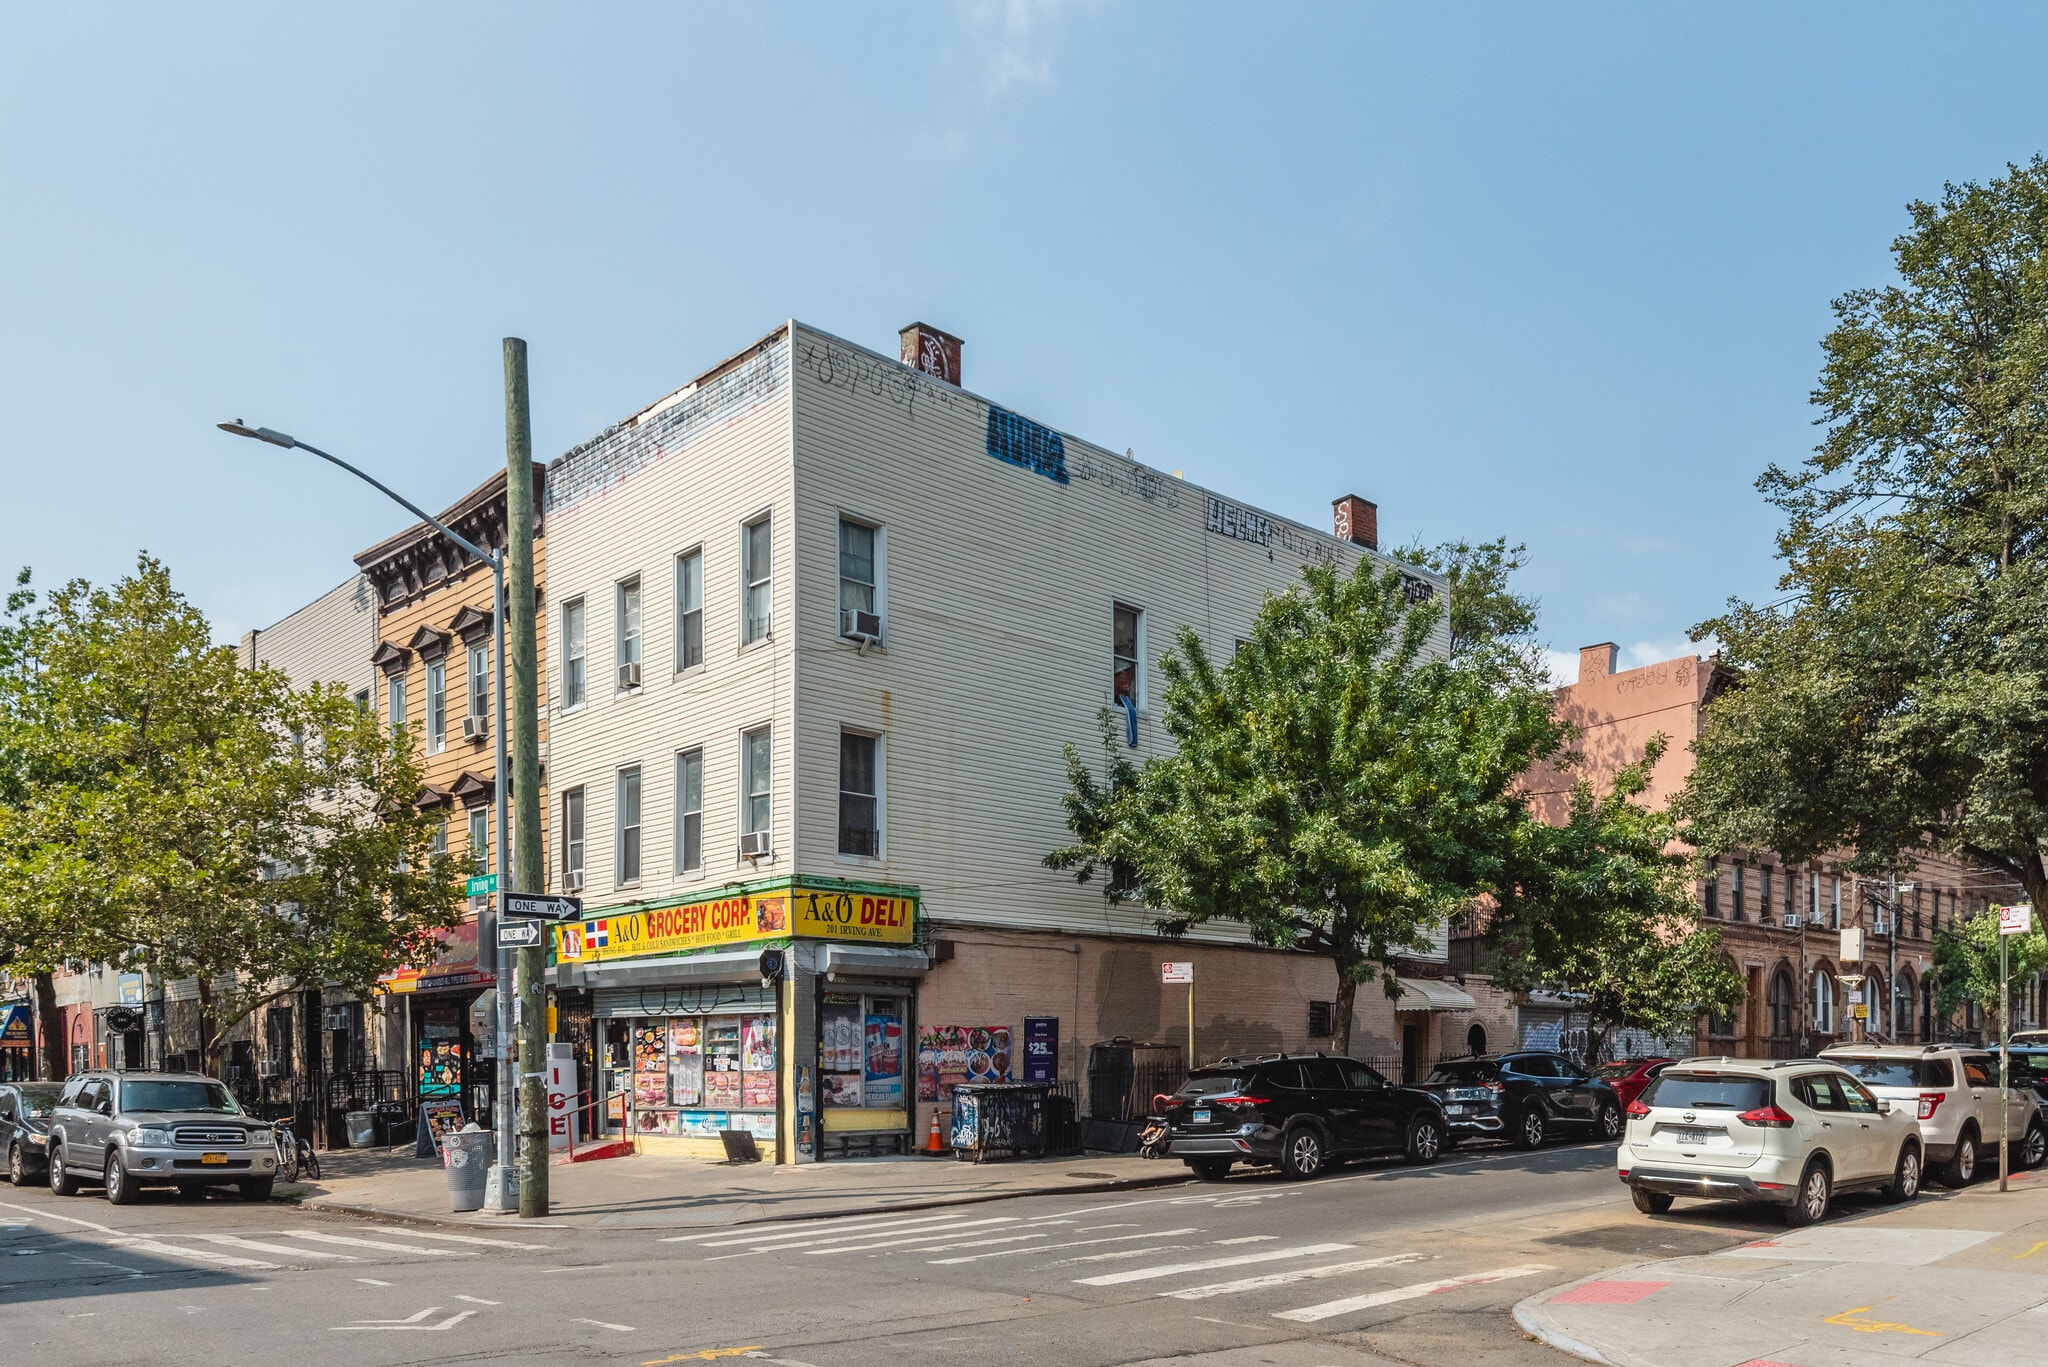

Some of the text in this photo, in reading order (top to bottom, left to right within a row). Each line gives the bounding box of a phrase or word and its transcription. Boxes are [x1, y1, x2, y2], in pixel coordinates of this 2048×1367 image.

[472, 879, 488, 893] Irving
[515, 901, 569, 913] ONE WAY
[804, 894, 906, 928] A&O DELI
[614, 898, 750, 944] A&O GROCERY CORP.
[504, 928, 533, 939] ONE WAY
[826, 924, 884, 938] 201 IRVING AVE.
[632, 943, 641, 952] HOT
[647, 940, 660, 950] COLD
[660, 935, 691, 949] SANDWICHES
[695, 934, 703, 944] HOT
[704, 932, 721, 943] FOOD
[725, 930, 741, 940] GRILL
[549, 1067, 566, 1135] ICE
